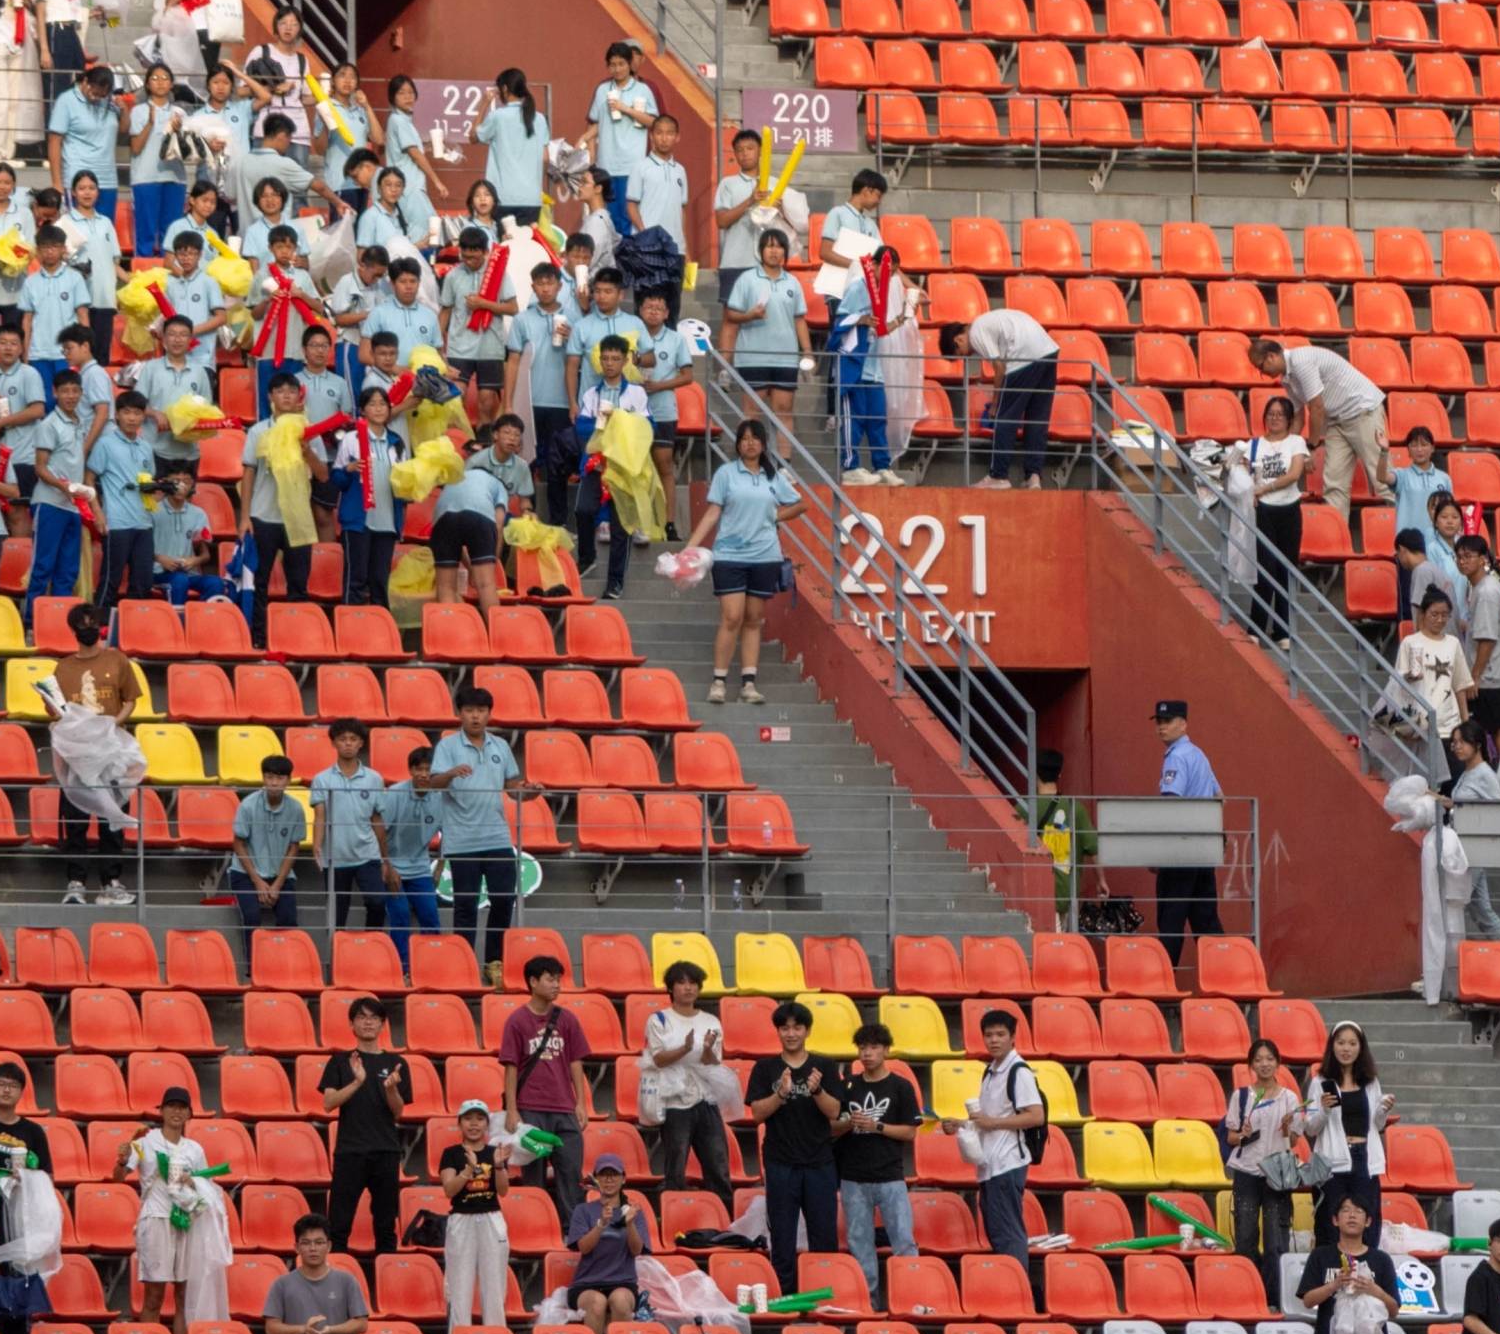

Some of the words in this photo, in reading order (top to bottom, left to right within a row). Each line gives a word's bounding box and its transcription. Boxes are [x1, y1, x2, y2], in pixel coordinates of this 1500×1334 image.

[772, 93, 830, 123] 220
[841, 512, 988, 597] 221
[922, 611, 996, 644] EXIT
